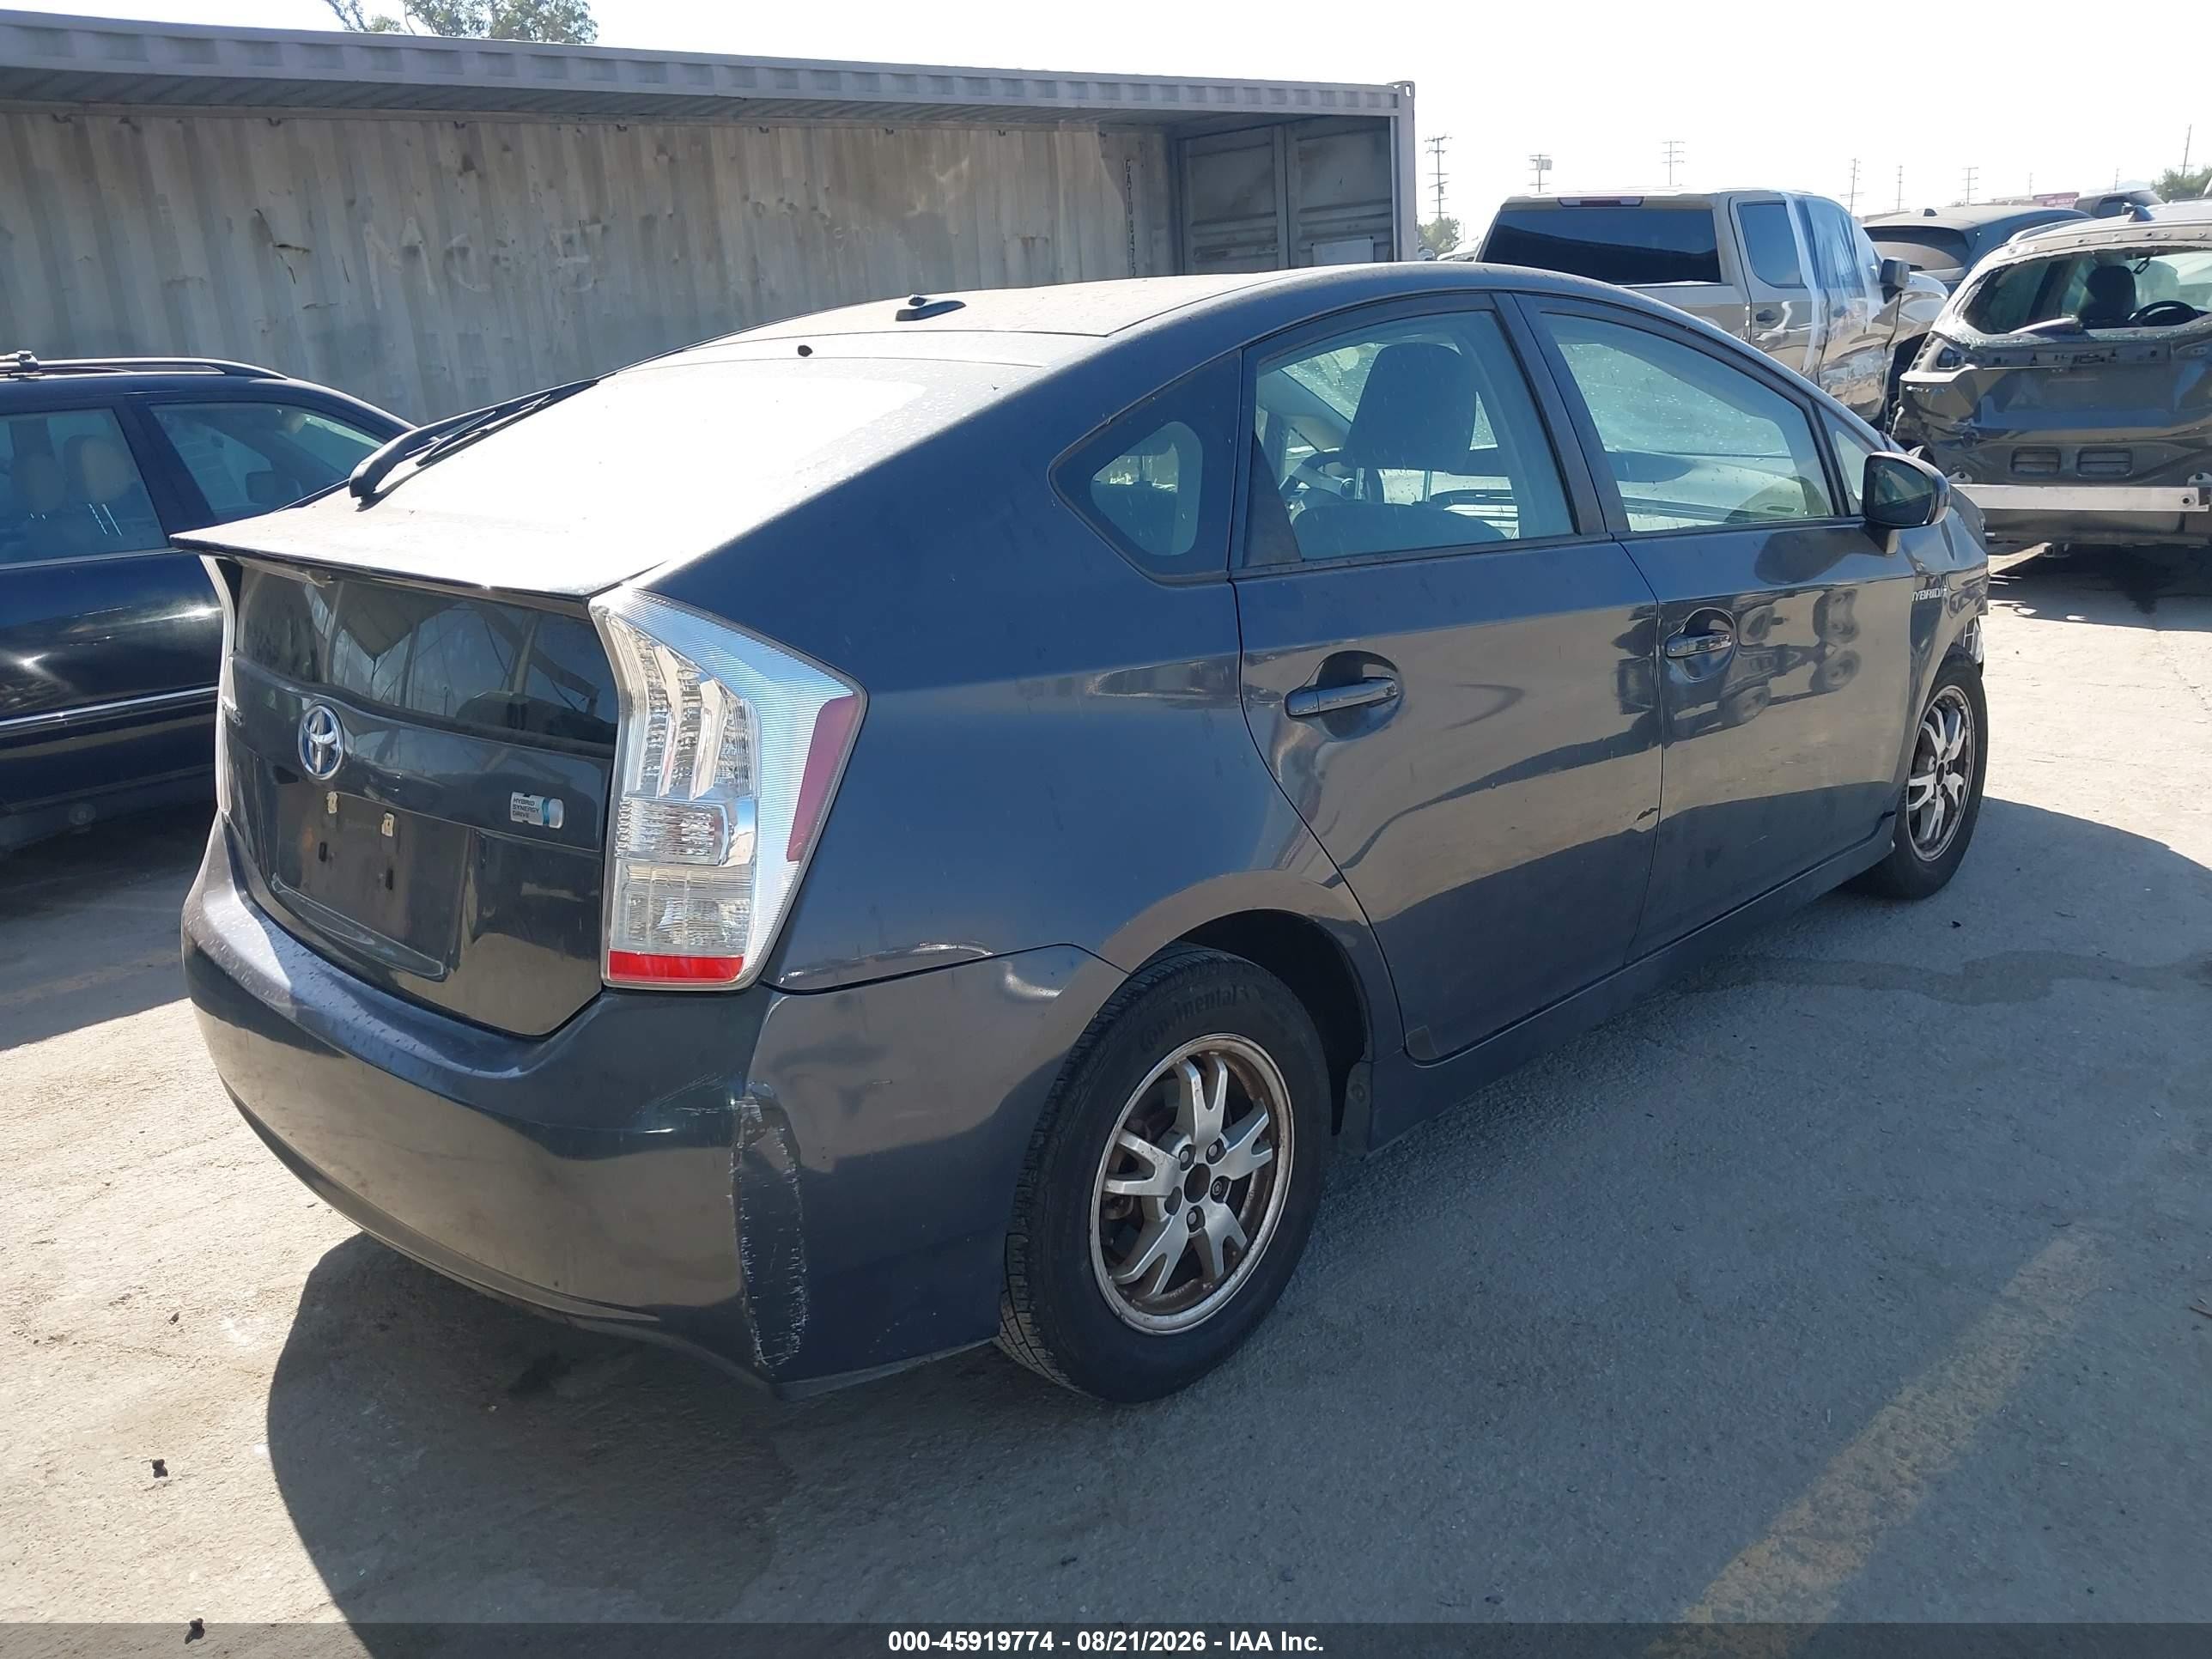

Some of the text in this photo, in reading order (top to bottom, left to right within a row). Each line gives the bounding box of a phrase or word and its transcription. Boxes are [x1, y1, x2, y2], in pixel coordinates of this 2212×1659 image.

[513, 798, 535, 806] HYBRID
[513, 804, 539, 813] SYNERGY
[513, 810, 530, 818] DRIVE
